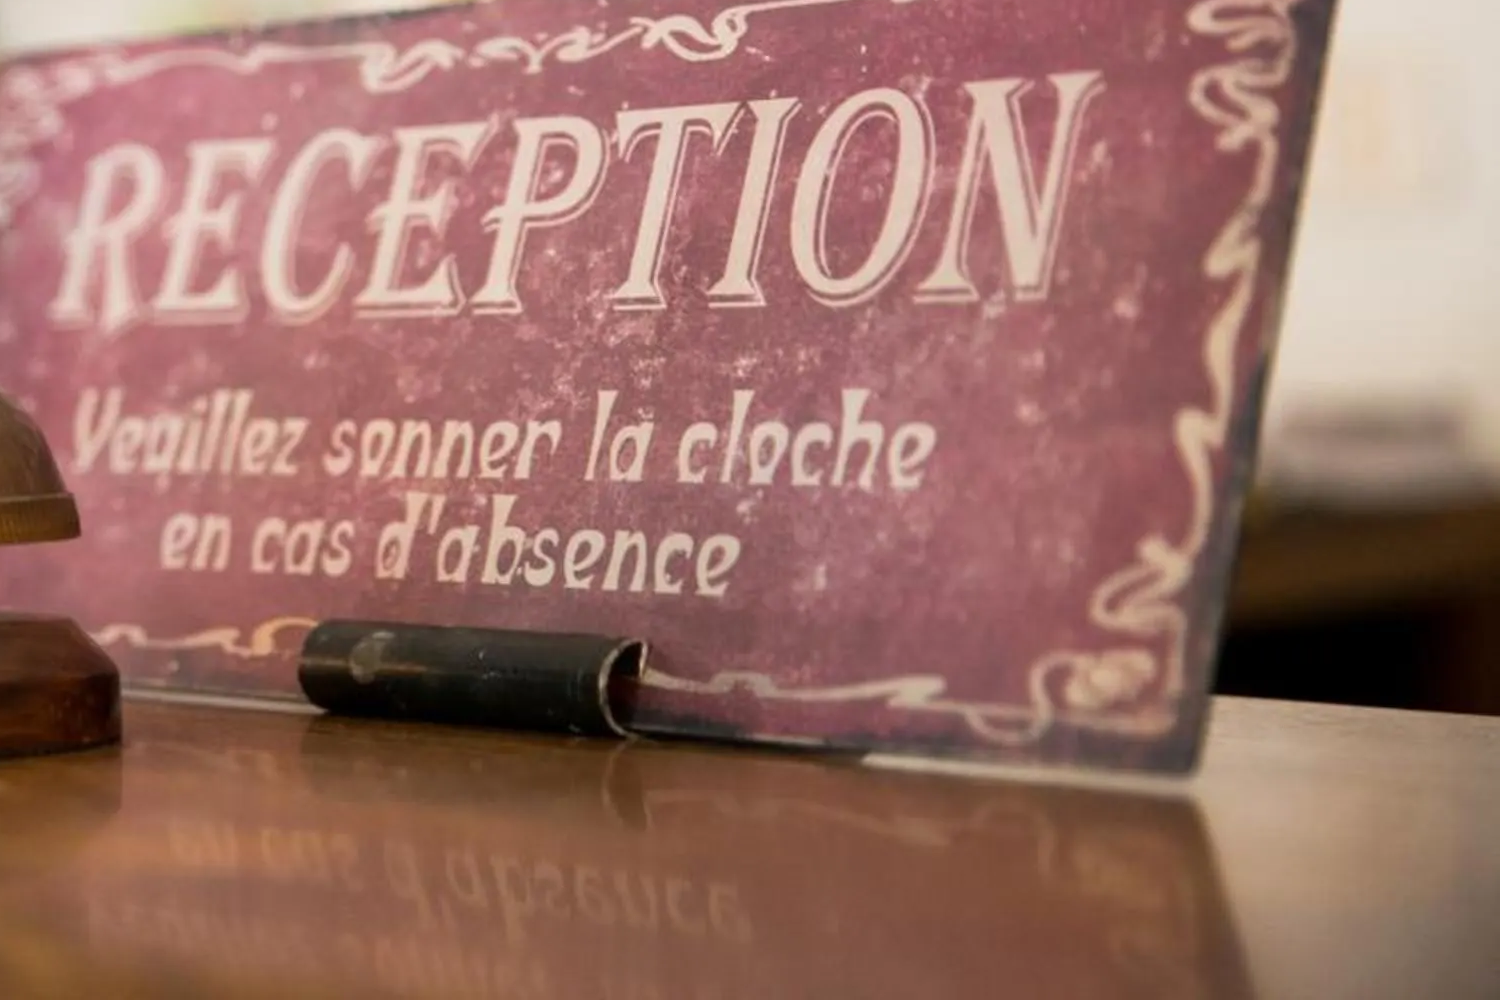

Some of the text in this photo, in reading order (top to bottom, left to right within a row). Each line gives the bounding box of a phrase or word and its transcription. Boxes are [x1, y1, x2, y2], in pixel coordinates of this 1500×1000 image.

[45, 70, 1103, 334] RECEPTION
[322, 418, 562, 480] sonner
[584, 389, 655, 483] la
[676, 387, 938, 492] cloche
[159, 490, 742, 598] en cas d'absence
